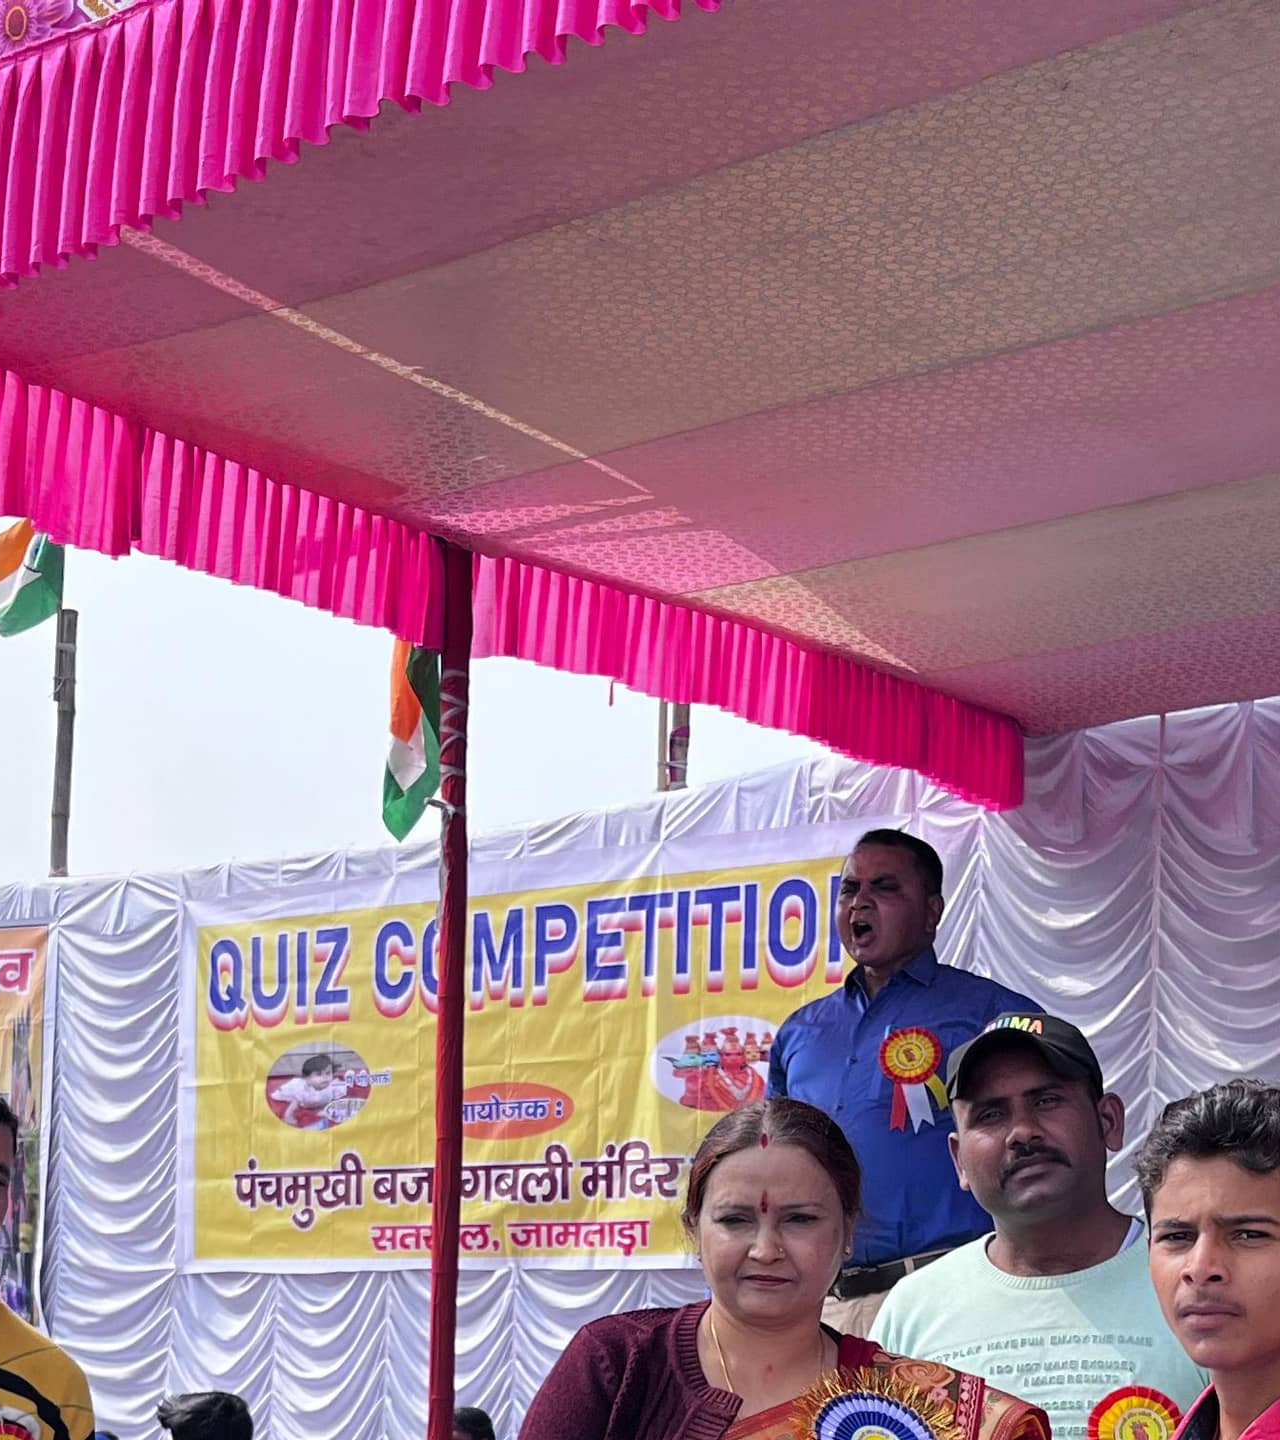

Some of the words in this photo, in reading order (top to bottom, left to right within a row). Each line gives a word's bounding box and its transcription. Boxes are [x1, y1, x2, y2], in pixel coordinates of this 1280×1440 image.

[207, 926, 352, 1031] QUIZ
[373, 874, 842, 1018] CMPETITIO
[235, 1153, 366, 1228] पंचमुखी
[373, 1144, 572, 1204] बजगबली
[581, 1141, 684, 1199] मंदिर
[508, 1221, 650, 1256] जामताड़ा
[987, 1338, 1018, 1351] HAVE
